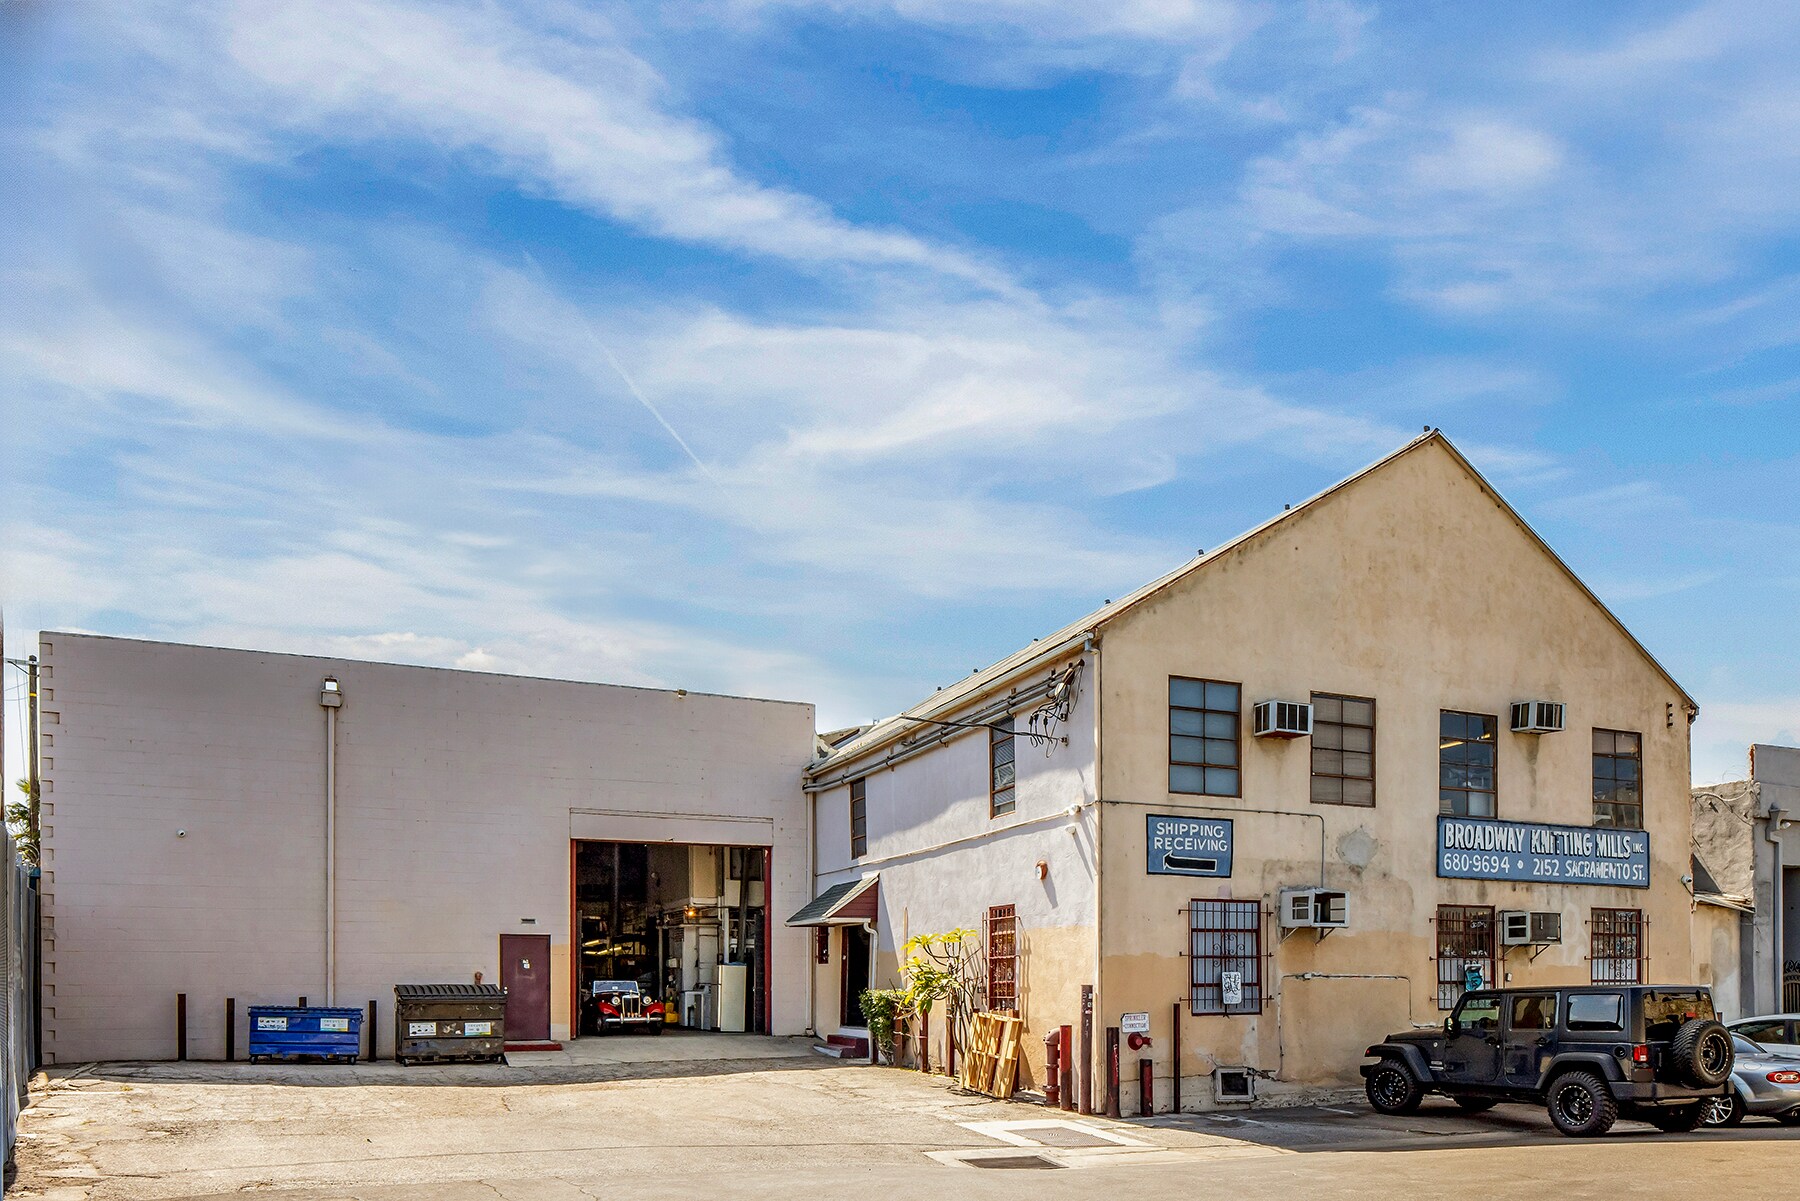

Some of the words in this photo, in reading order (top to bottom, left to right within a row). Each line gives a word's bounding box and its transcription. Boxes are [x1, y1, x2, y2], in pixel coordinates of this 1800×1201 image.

[1156, 822, 1225, 838] SHIPPING
[1154, 837, 1228, 852] RECEIVING
[1445, 823, 1525, 853] BROADWAY
[1530, 829, 1593, 856] KNITTING
[1595, 833, 1631, 859] MILLS
[1532, 858, 1560, 877] 2152
[1565, 860, 1631, 880] SACRAMENTO
[1632, 864, 1646, 881] ST.
